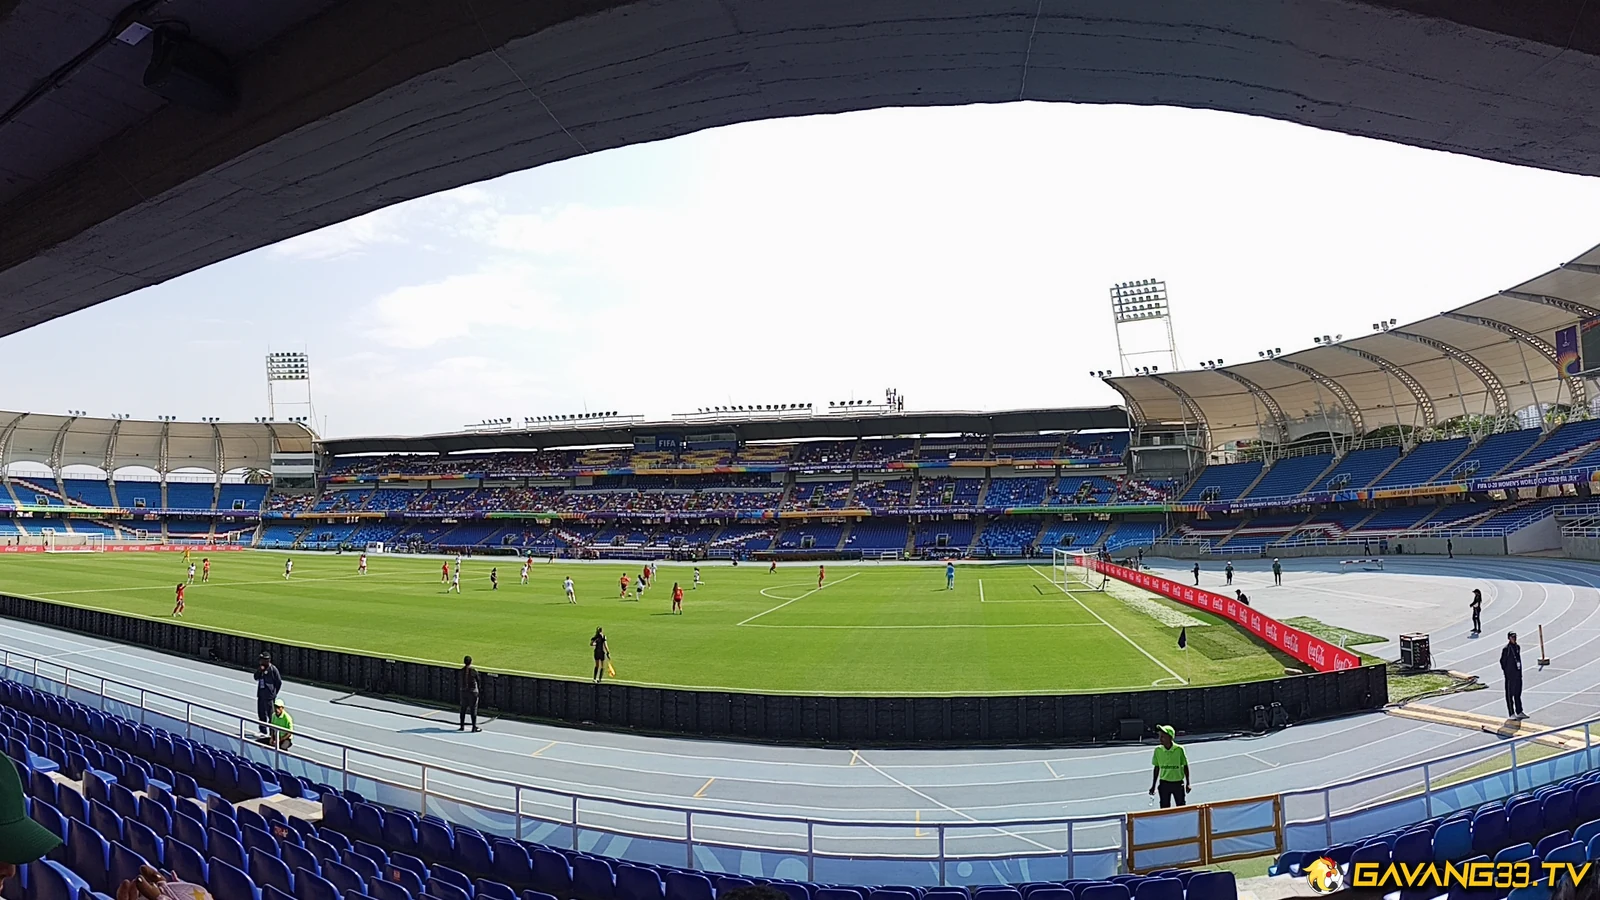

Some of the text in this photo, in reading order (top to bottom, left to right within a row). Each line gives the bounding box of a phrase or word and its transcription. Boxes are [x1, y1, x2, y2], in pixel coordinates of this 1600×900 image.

[658, 439, 676, 447] FIFA
[1266, 621, 1277, 641] Coca-Cola
[1284, 630, 1299, 653] Coca-Cola
[1308, 640, 1325, 666] Coca-Cola
